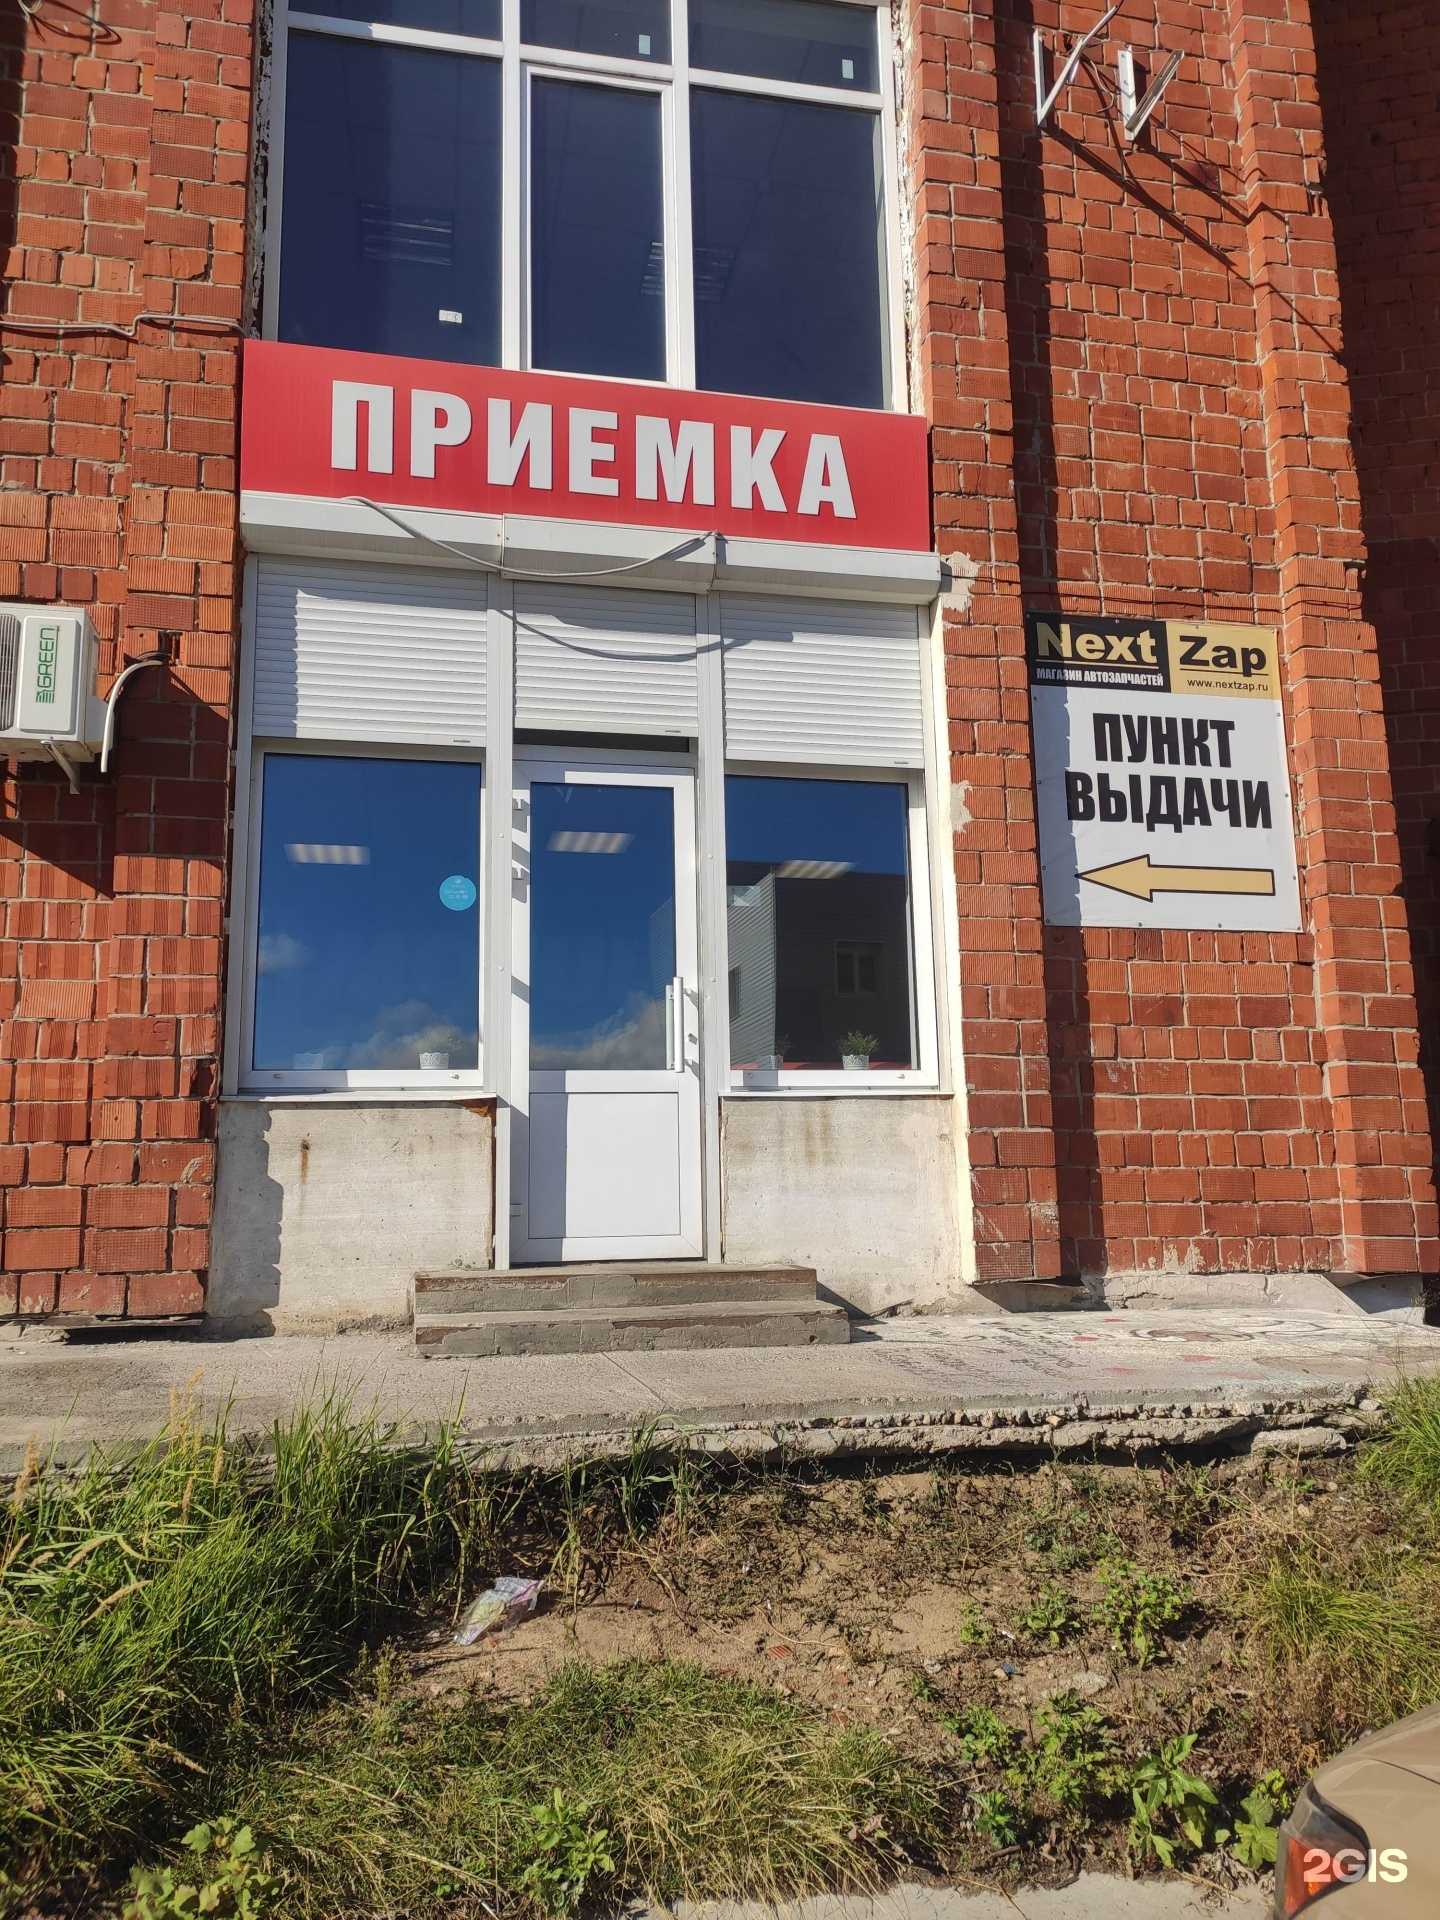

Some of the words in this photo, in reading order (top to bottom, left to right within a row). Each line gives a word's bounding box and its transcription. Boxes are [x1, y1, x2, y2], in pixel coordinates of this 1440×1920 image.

[331, 380, 857, 519] ПРИЕМКА
[37, 625, 58, 690] GREEN
[1036, 622, 1157, 664] Next
[1179, 635, 1267, 677] Zap
[1036, 667, 1083, 681] МАГАЗИН
[1084, 670, 1164, 686] АВТОЗАПЧАСТЕЙ
[1187, 680, 1268, 692] www.nextzap.ru
[1092, 713, 1235, 768] ПУНКТ
[1065, 771, 1272, 833] ВЫДАЧИ
